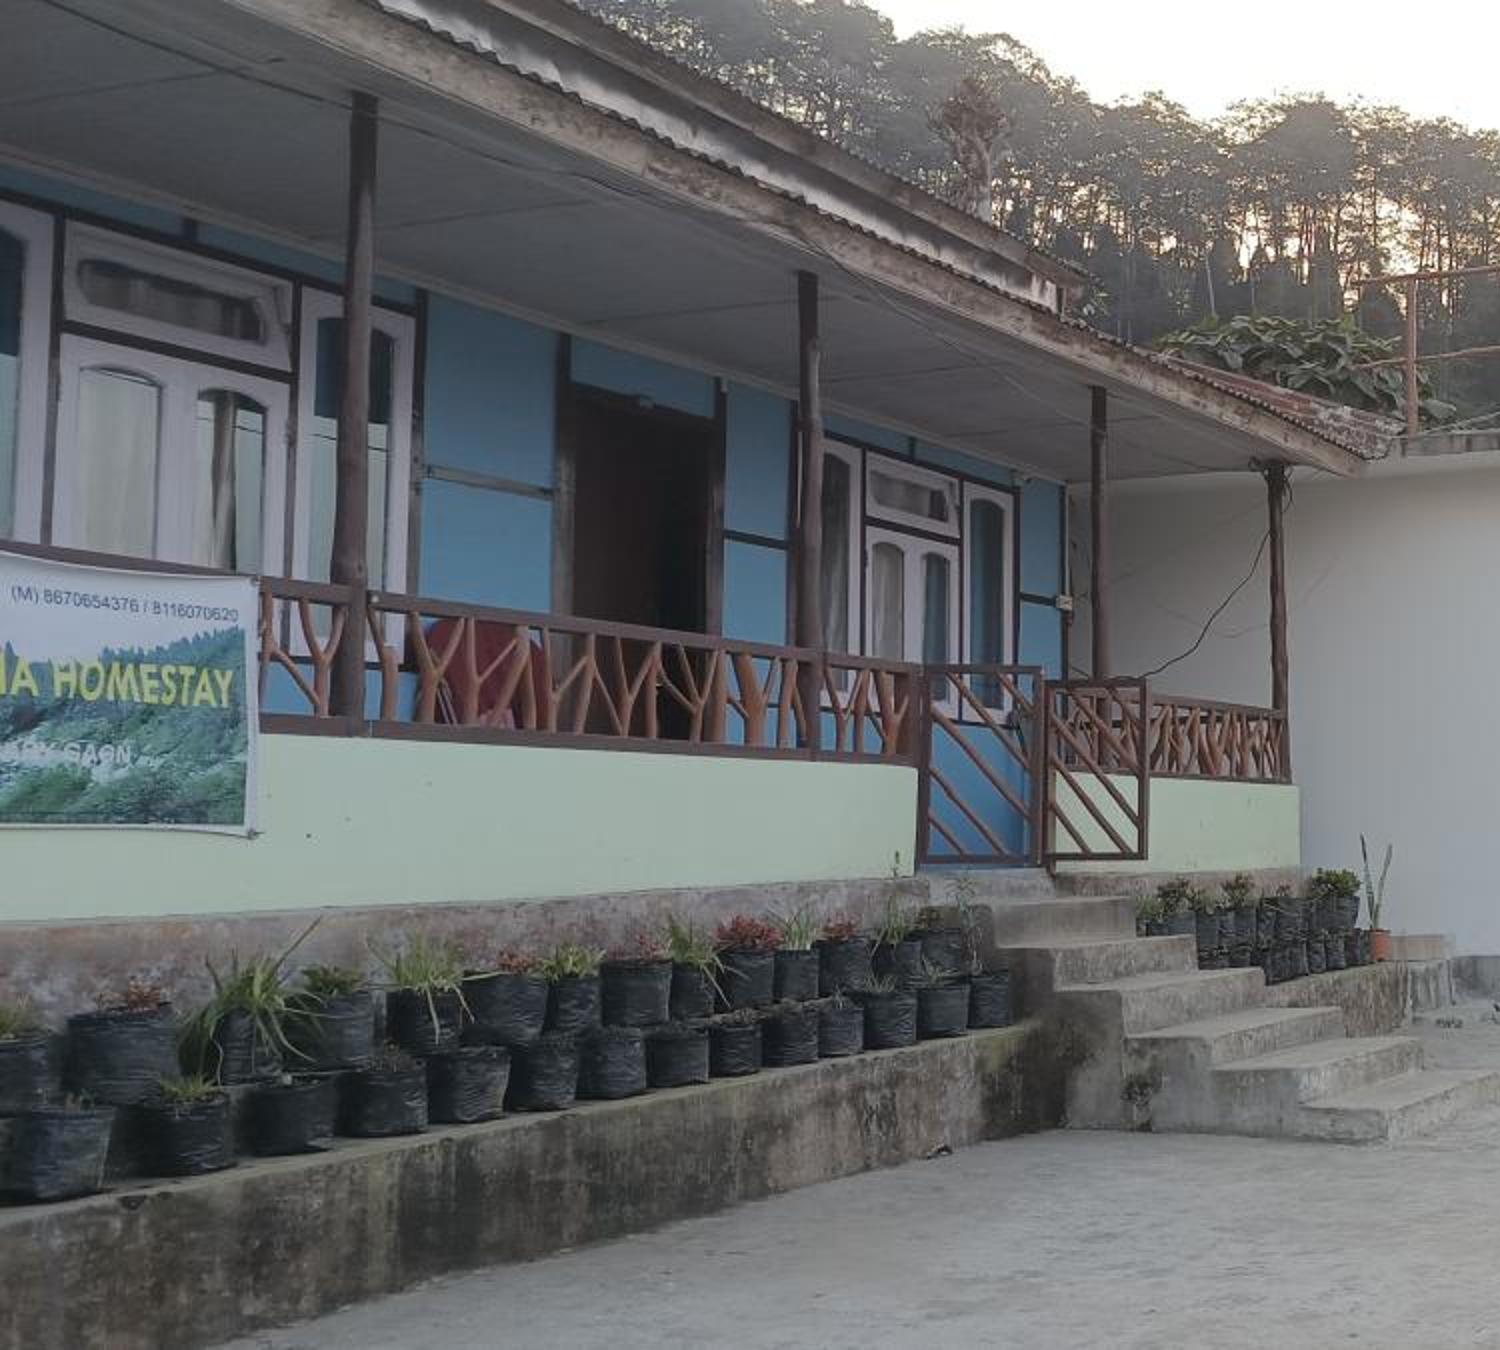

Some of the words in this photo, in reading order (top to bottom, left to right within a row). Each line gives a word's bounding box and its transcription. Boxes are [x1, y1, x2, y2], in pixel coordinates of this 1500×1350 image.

[11, 585, 39, 604] (M)
[43, 589, 139, 612] 8670654376
[51, 657, 233, 708] HOMESTAY
